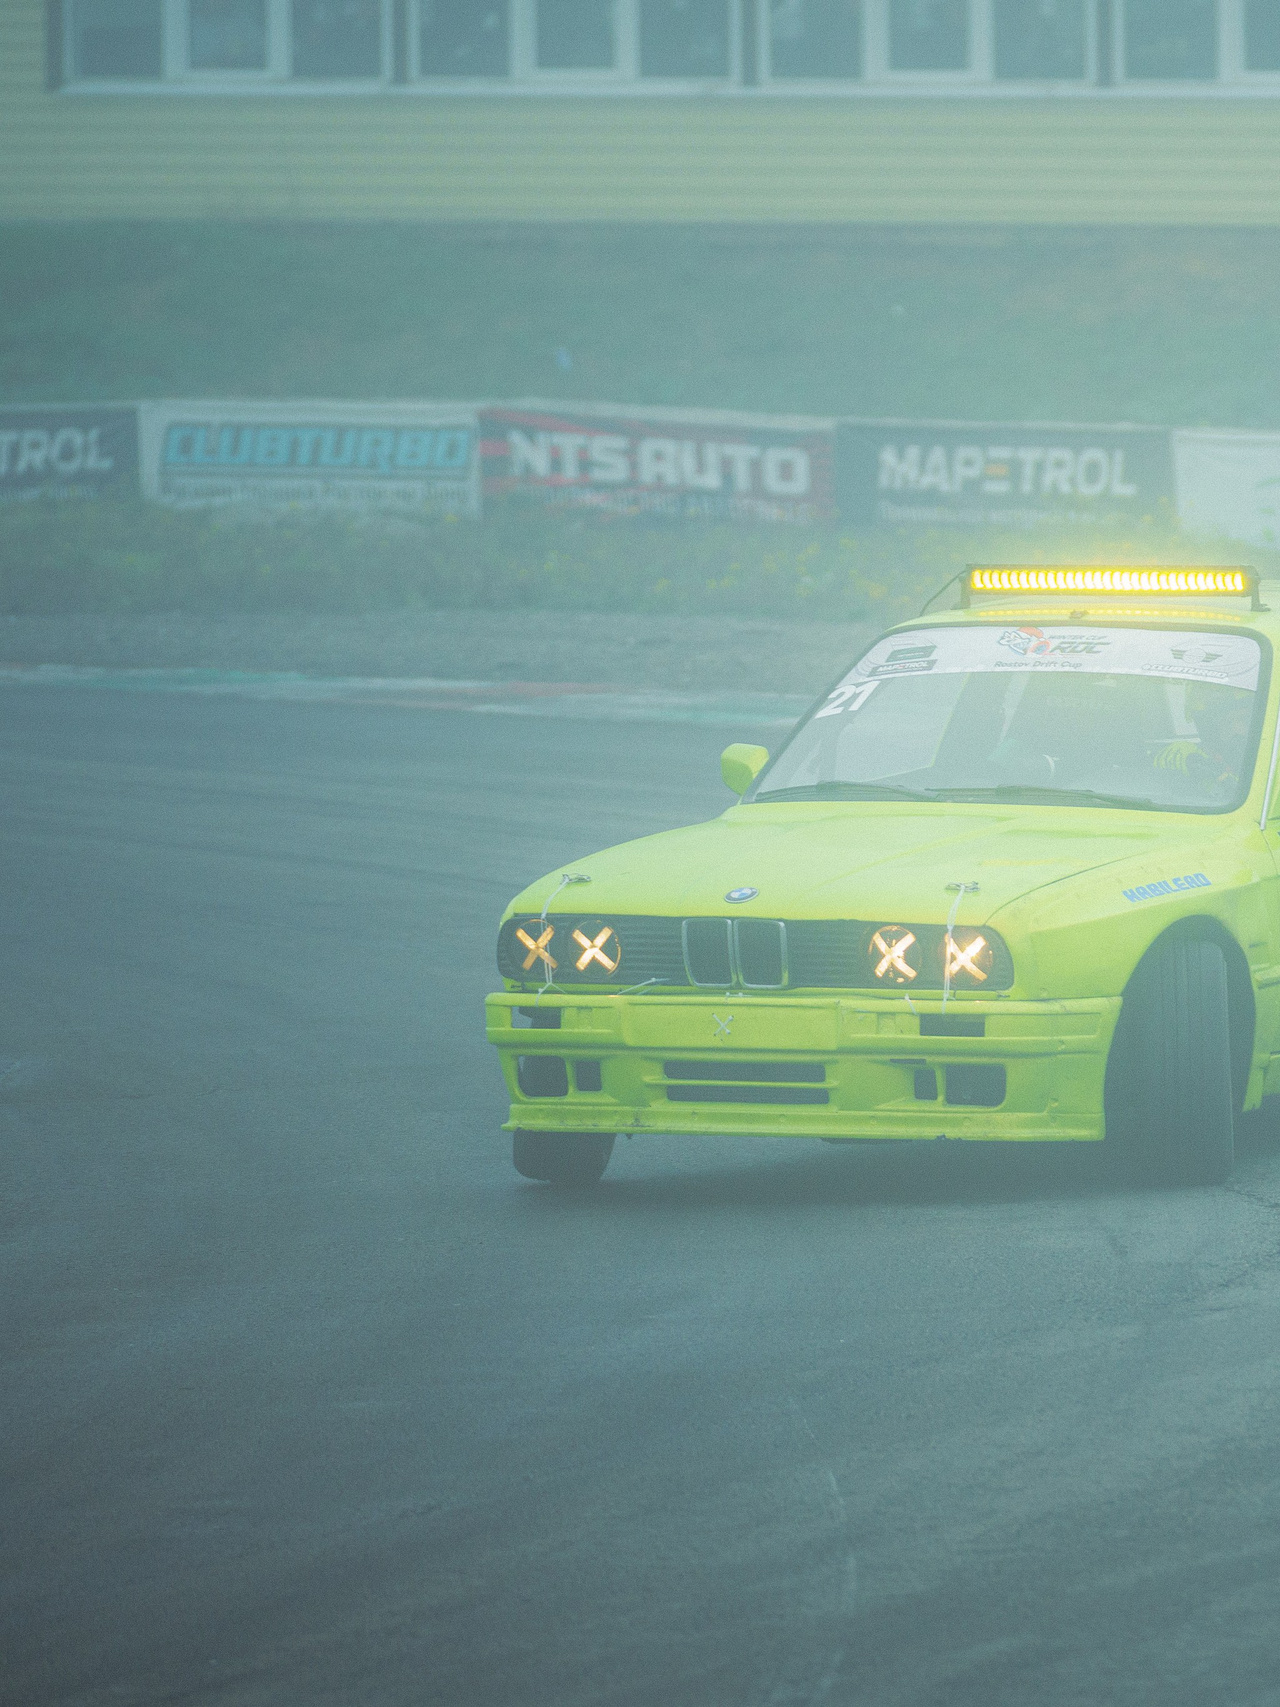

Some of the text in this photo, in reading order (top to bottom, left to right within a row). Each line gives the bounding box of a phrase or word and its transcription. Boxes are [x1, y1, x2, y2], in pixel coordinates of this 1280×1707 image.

[165, 426, 469, 474] CLUBTURBO
[877, 444, 1138, 496] MAPETROL
[994, 660, 1083, 669] Rostov Drift Cup
[1049, 641, 1113, 654] RDC
[814, 681, 881, 719] 21
[1122, 872, 1213, 903] HABILEAD
